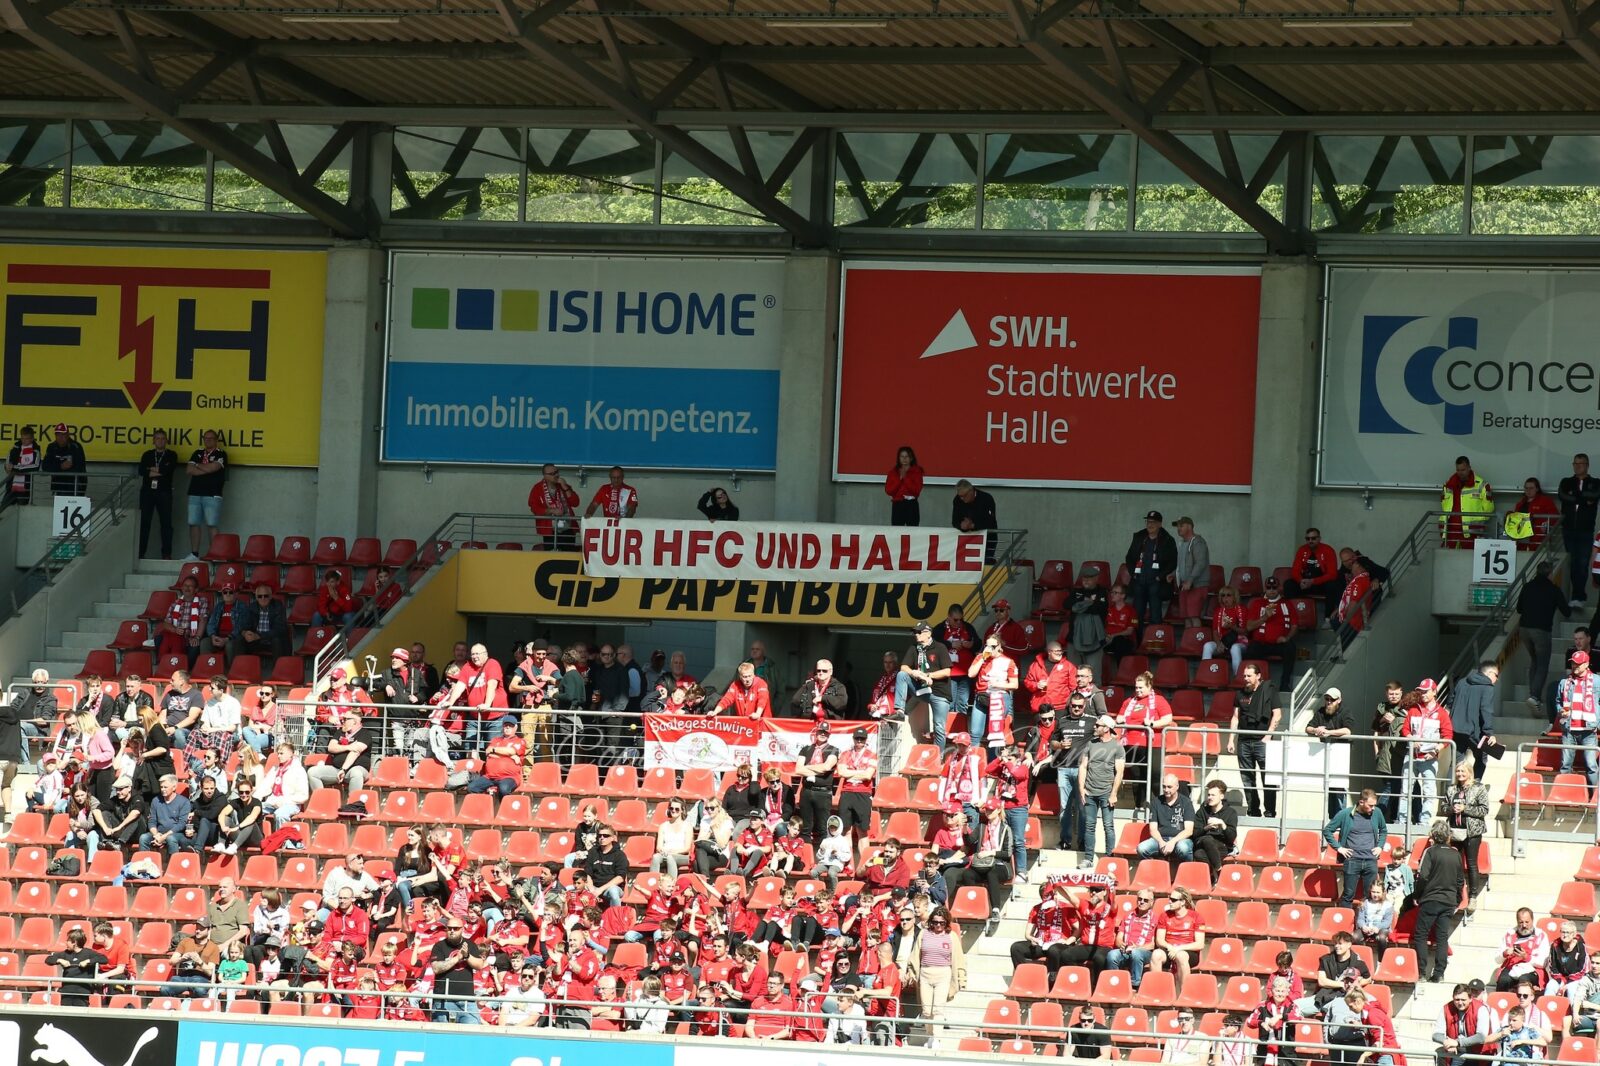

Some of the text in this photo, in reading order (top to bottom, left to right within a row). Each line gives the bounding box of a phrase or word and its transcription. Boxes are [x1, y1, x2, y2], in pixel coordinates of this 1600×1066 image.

[547, 289, 603, 333] ISI
[988, 314, 1077, 349] SWH.
[986, 363, 1177, 400] Stadtwerke
[1446, 360, 1600, 411] conce
[195, 394, 244, 410] GmbH
[406, 395, 759, 442] Immobilien. Kompetenz.
[985, 410, 1070, 445] Halle
[60, 506, 84, 530] 16
[584, 519, 985, 571] FÜR HFC UND HALLE
[1481, 550, 1509, 576] 15
[639, 577, 941, 620] PAPENBURG
[651, 717, 753, 738] Saalegeschwüre
